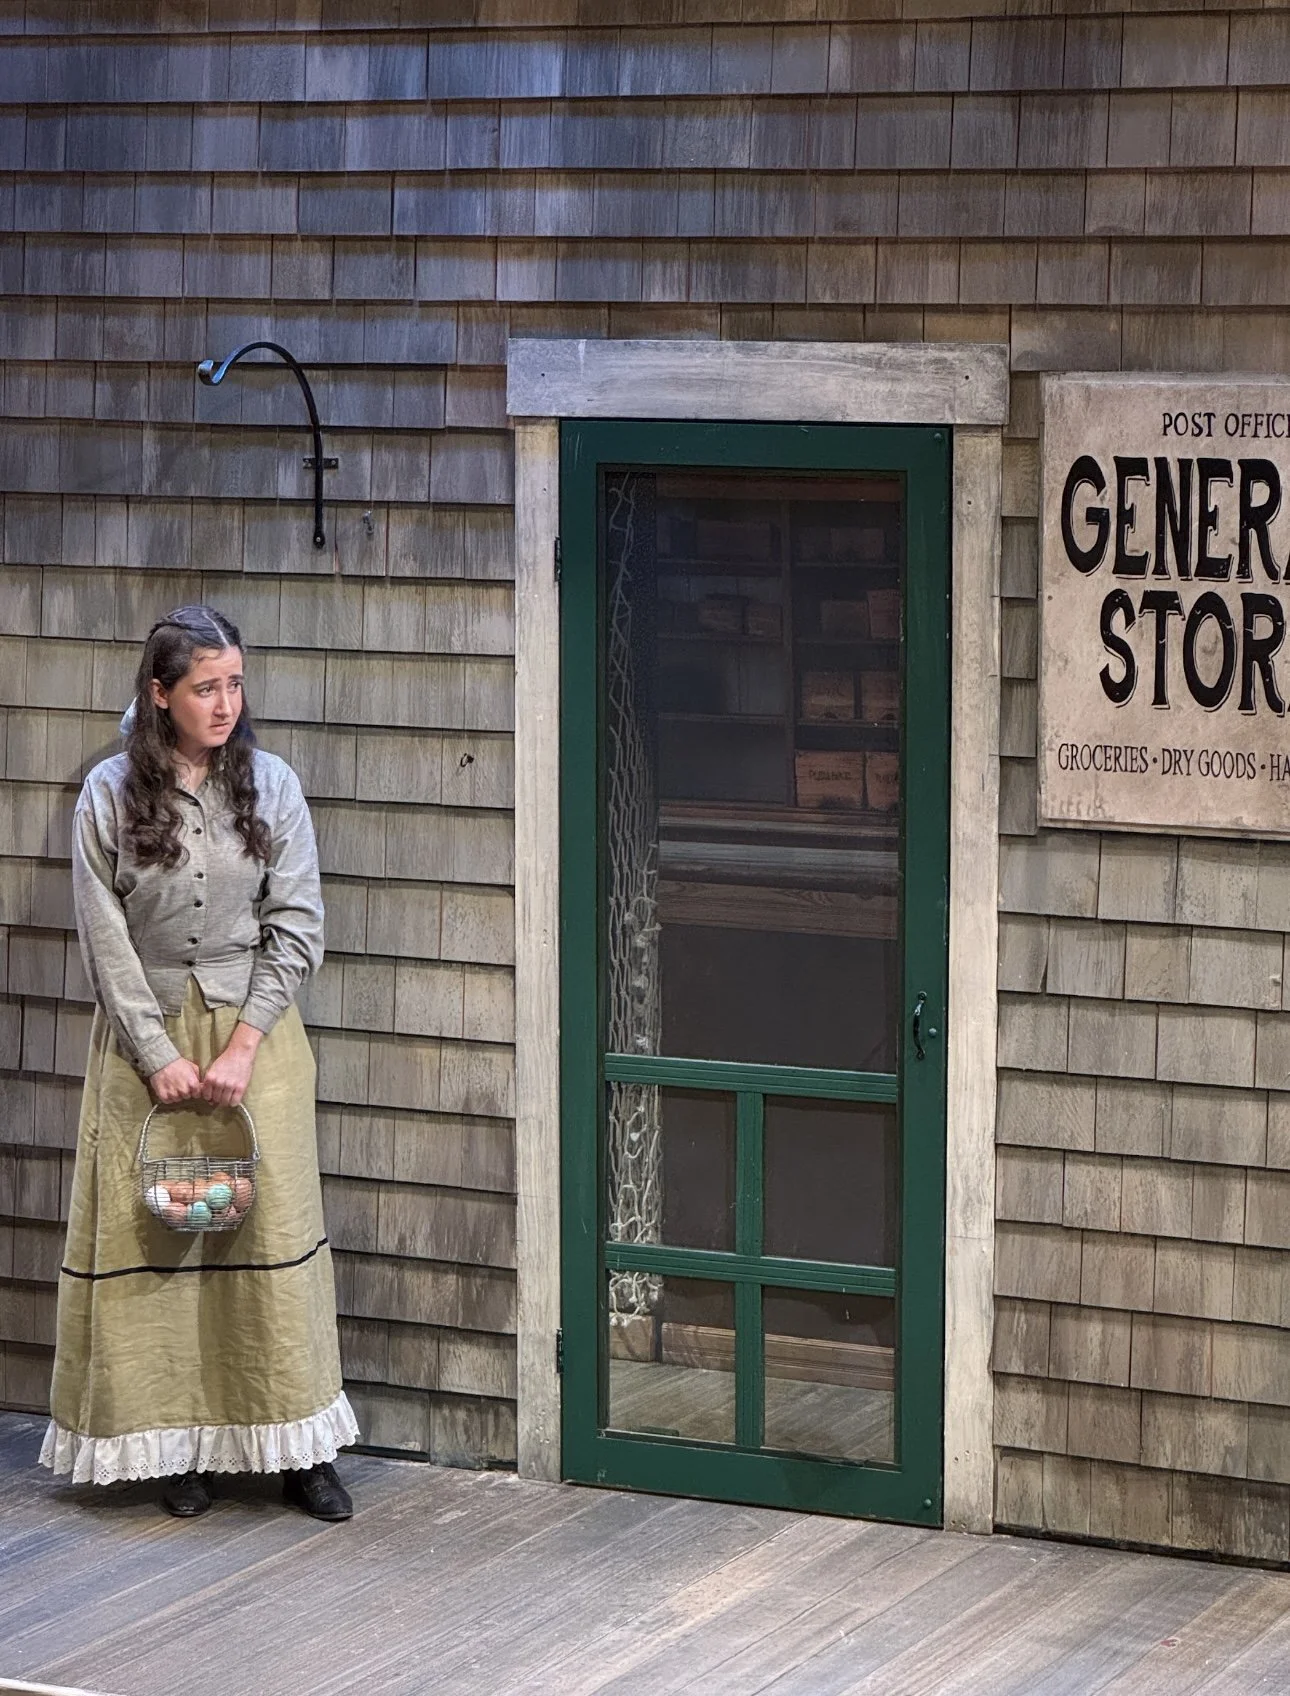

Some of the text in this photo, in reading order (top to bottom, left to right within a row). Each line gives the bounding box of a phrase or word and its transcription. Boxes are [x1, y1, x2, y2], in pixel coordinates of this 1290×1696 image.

[1162, 411, 1216, 438] POST
[1060, 454, 1290, 585] GENER
[1099, 588, 1290, 718] STOR
[1058, 743, 1149, 774] GROCERIES
[1161, 747, 1195, 777] DRY
[1199, 749, 1257, 781] GOODS
